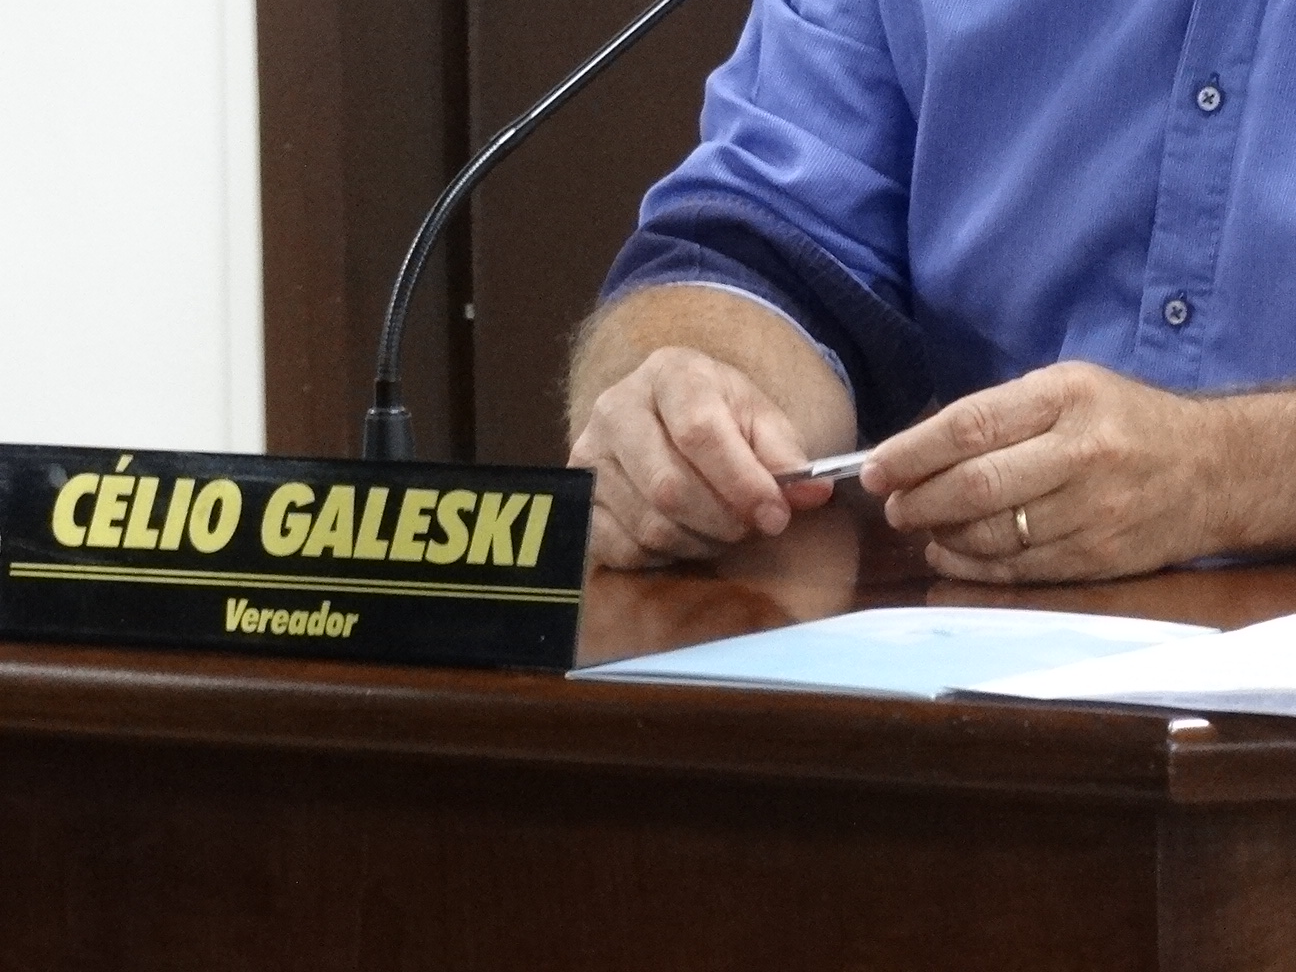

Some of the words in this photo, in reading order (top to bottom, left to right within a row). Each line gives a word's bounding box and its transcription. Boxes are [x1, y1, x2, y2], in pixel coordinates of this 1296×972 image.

[51, 454, 243, 554] CÉLIO
[260, 481, 553, 567] GALESKI
[225, 598, 359, 637] Vereador
